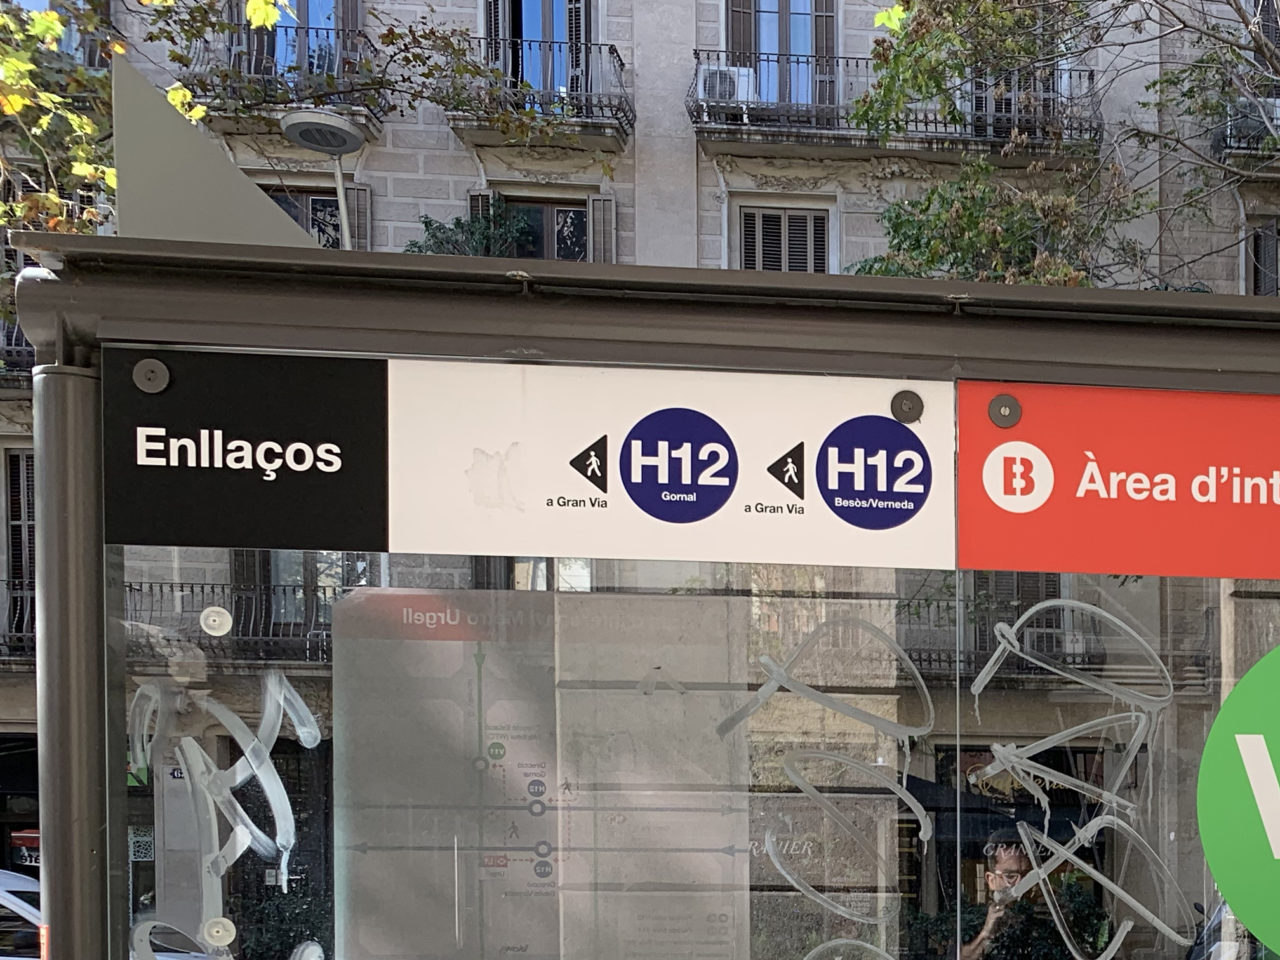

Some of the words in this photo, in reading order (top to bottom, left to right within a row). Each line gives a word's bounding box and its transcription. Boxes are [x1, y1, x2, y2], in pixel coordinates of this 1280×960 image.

[136, 427, 342, 481] Enllaços
[630, 440, 730, 486] H12
[827, 447, 925, 494] H12
[1077, 451, 1176, 501] Àrea
[546, 498, 553, 507] a
[556, 497, 586, 507] Gran
[589, 497, 608, 508] Via
[661, 490, 697, 502] Gornal
[744, 506, 751, 514] a
[754, 504, 783, 515] Gran
[786, 504, 805, 515] Via
[834, 497, 914, 510] Besòs/Verneda
